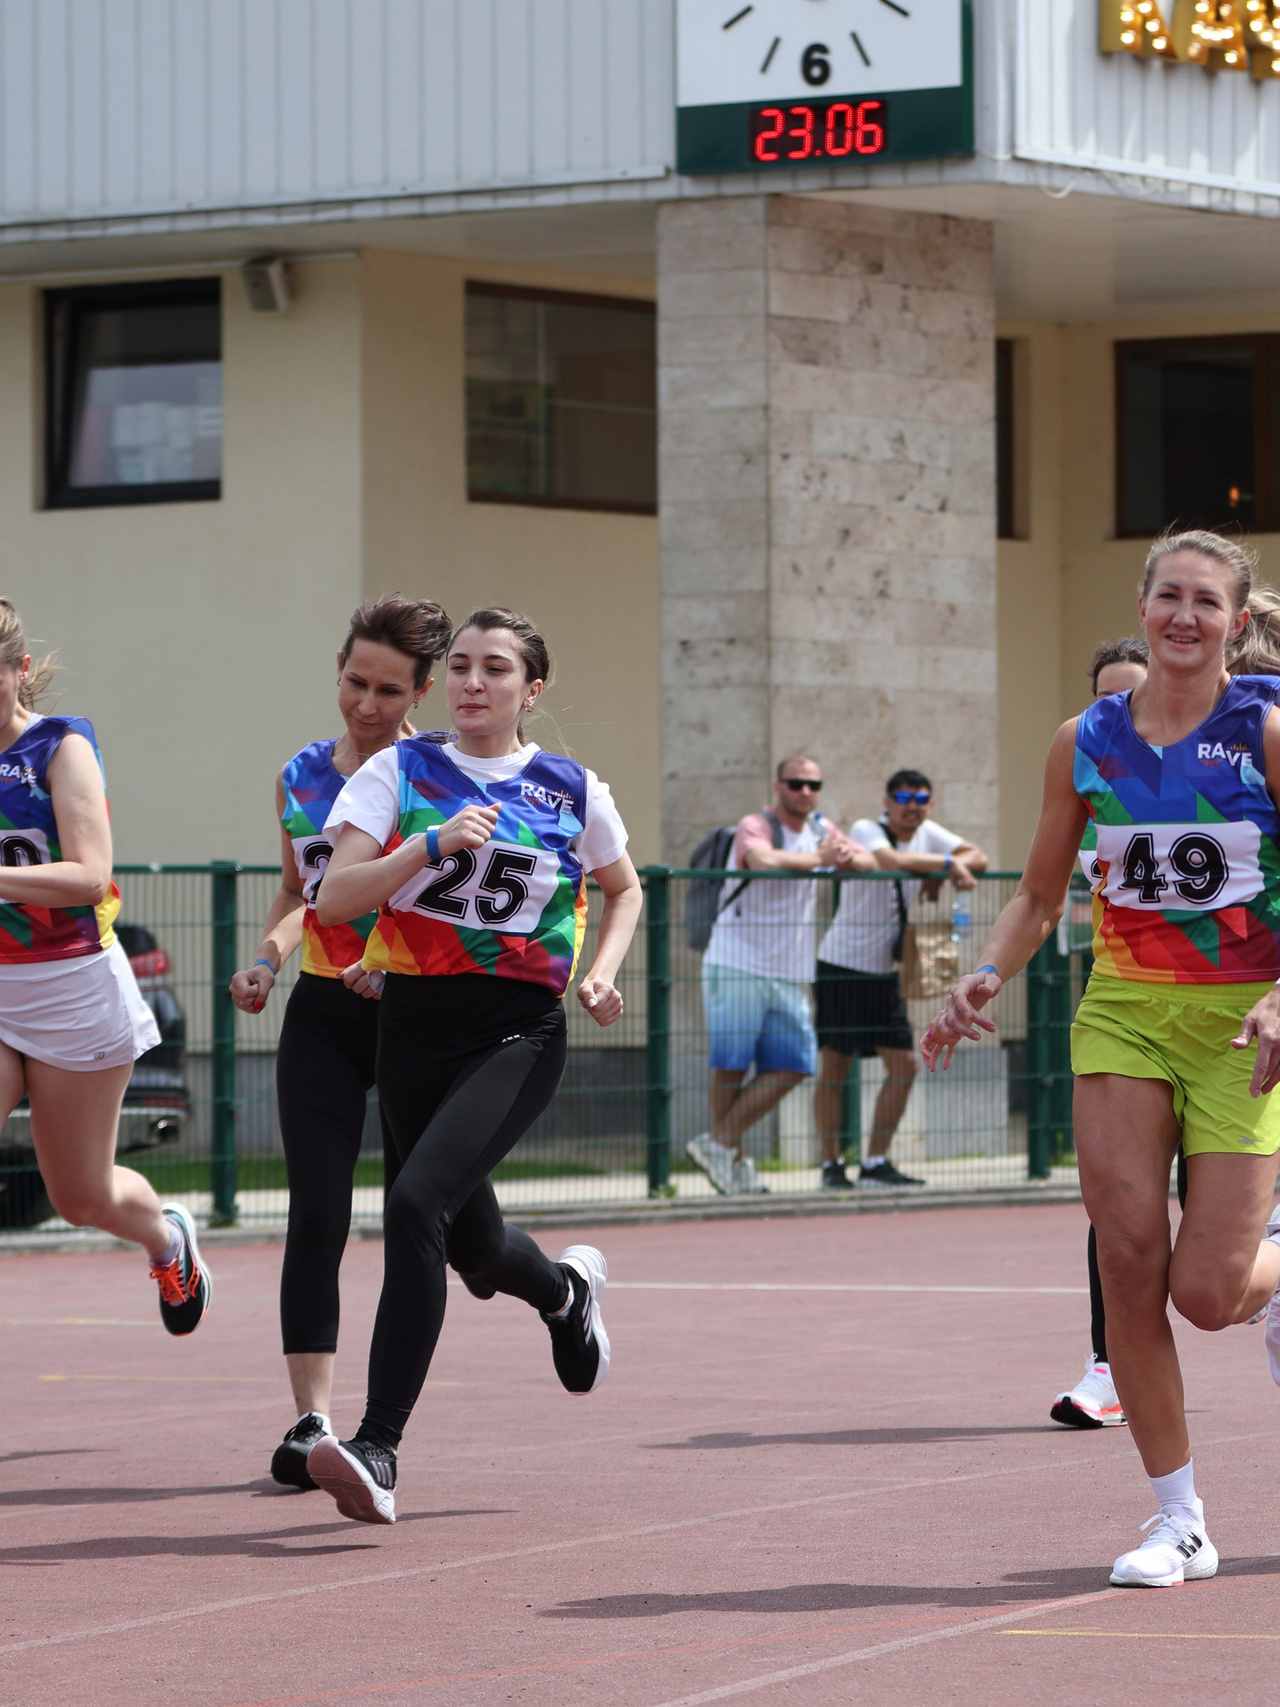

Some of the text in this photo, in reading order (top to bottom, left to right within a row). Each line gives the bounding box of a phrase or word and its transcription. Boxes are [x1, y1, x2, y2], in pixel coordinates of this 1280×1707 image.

[801, 43, 830, 86] 6
[754, 100, 883, 161] 23.06
[1197, 742, 1253, 767] RAVE
[520, 782, 575, 815] RAVE
[413, 847, 538, 925] 25
[1118, 832, 1229, 904] 49
